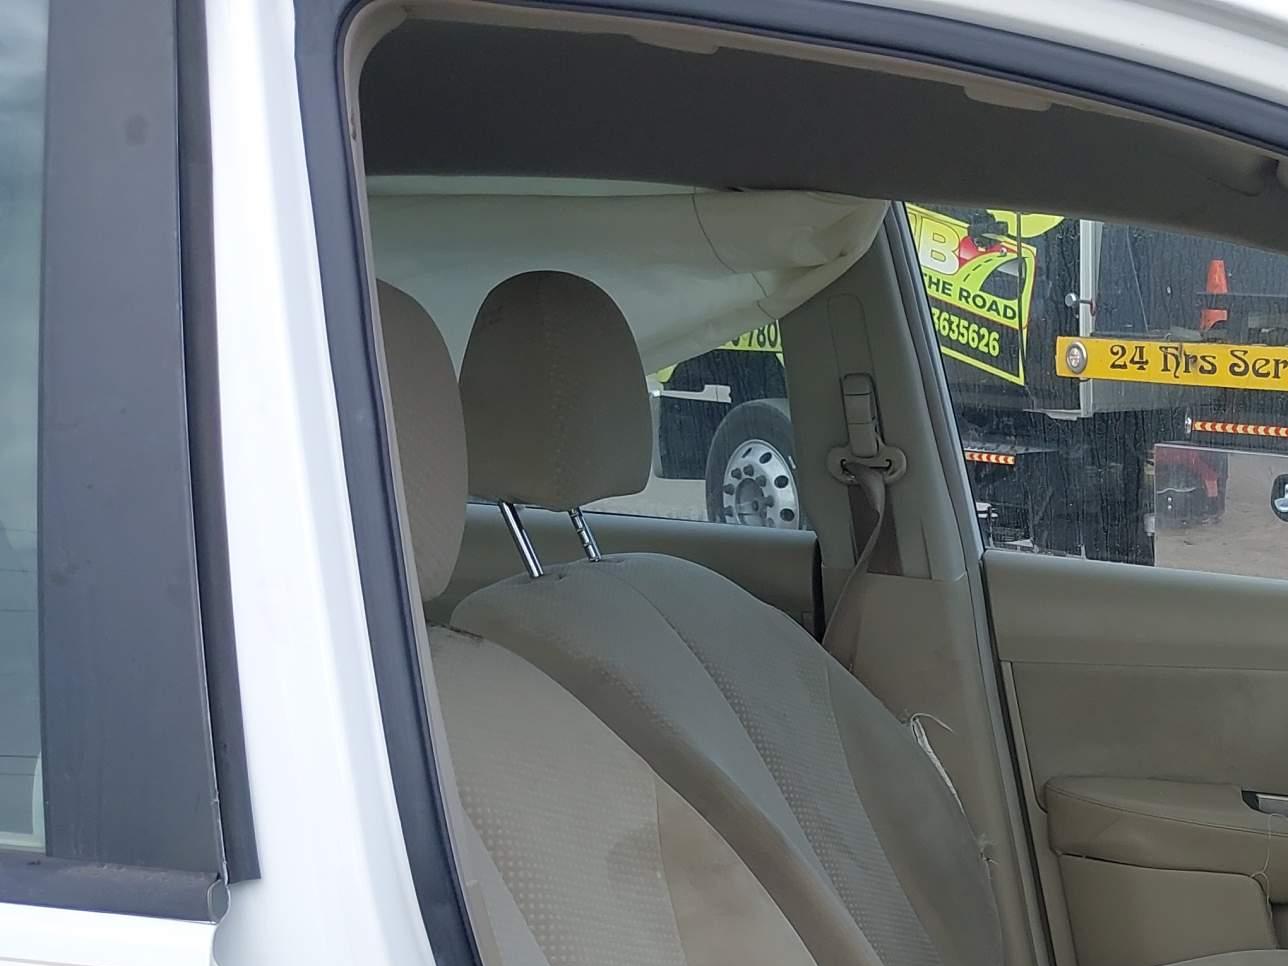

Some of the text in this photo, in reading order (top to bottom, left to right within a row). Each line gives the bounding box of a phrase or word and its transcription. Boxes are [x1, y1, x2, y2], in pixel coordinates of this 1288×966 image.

[959, 287, 1017, 320] ROAD
[1110, 344, 1149, 370] 24
[1159, 345, 1217, 379] Hrs
